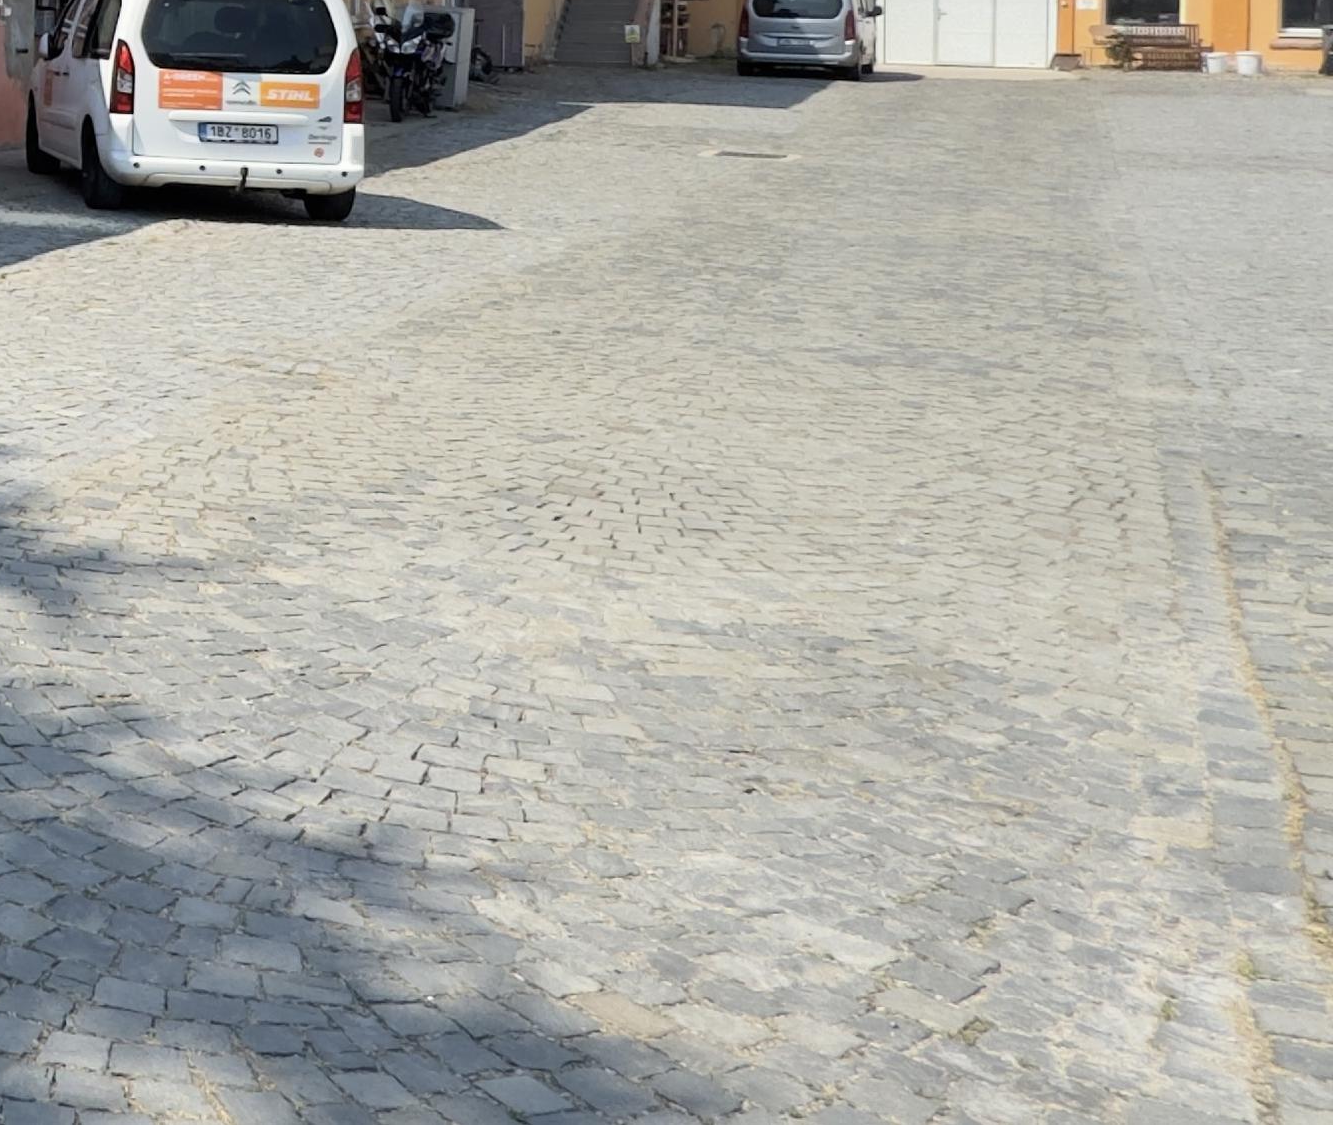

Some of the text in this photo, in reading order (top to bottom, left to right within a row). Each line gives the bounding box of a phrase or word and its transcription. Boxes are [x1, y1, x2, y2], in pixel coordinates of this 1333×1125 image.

[266, 88, 314, 102] STIHL
[211, 125, 272, 140] 1BZ 8016
